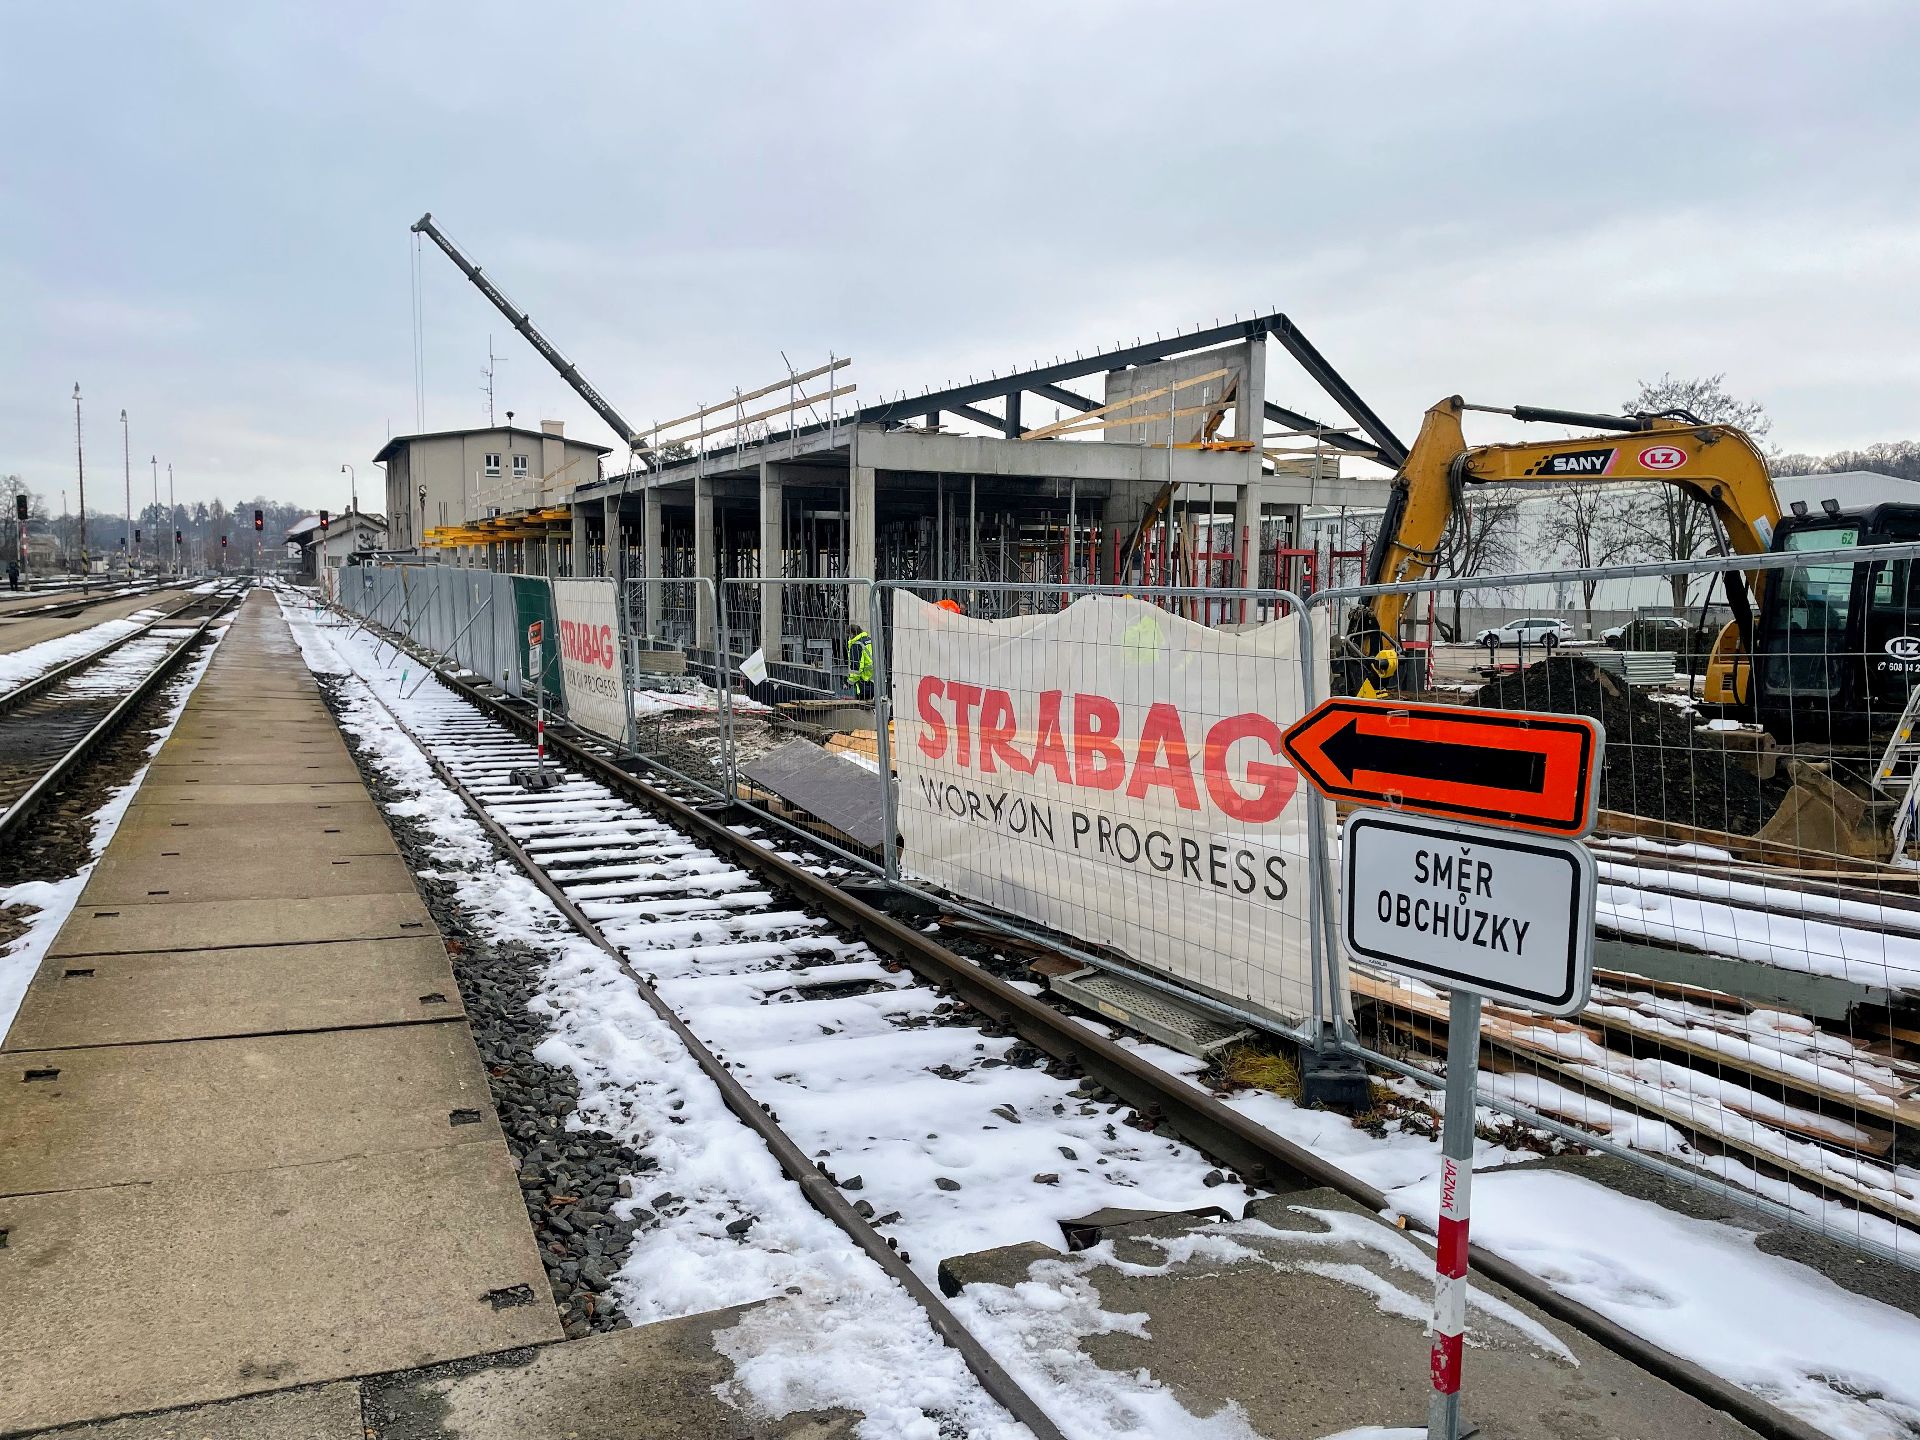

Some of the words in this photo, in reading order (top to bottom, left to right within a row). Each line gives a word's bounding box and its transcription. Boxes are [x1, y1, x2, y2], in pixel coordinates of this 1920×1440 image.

[1553, 456, 1605, 471] SANY
[1841, 532, 1854, 545] 62
[1895, 641, 1919, 654] LZ
[917, 675, 1299, 824] STRABAG
[1072, 810, 1289, 900] PROGRESS
[1413, 846, 1493, 898] SMĚR
[1377, 889, 1530, 956] OBCHŮZKY
